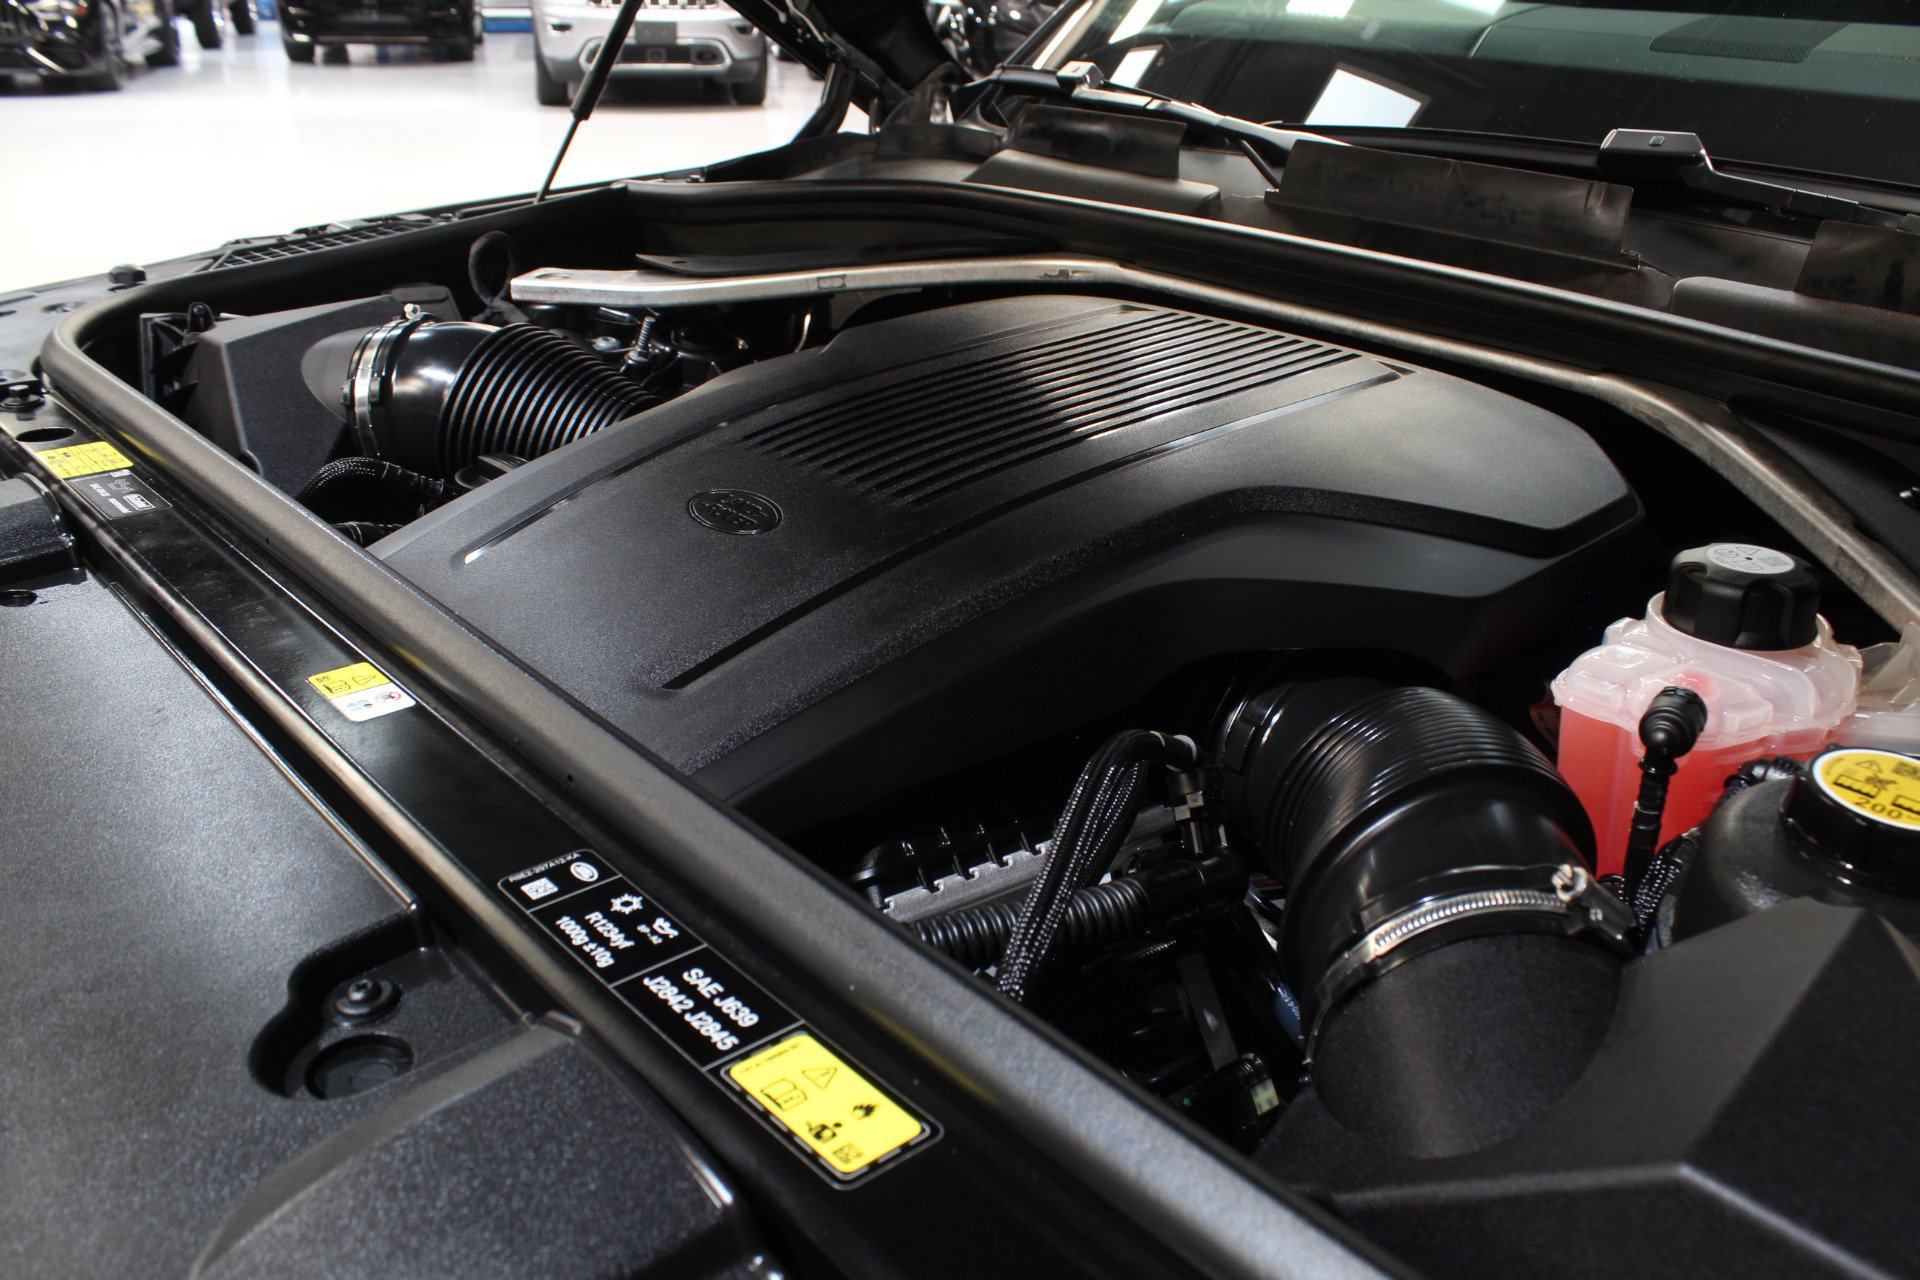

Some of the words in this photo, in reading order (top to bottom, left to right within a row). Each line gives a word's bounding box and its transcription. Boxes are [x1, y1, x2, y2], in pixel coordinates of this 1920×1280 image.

[555, 915, 590, 946] 1000g
[584, 911, 635, 949] R1234yf
[643, 975, 694, 1014] J2842
[684, 1011, 740, 1051] J2845
[682, 968, 725, 999] SAE
[713, 996, 759, 1028] J639
